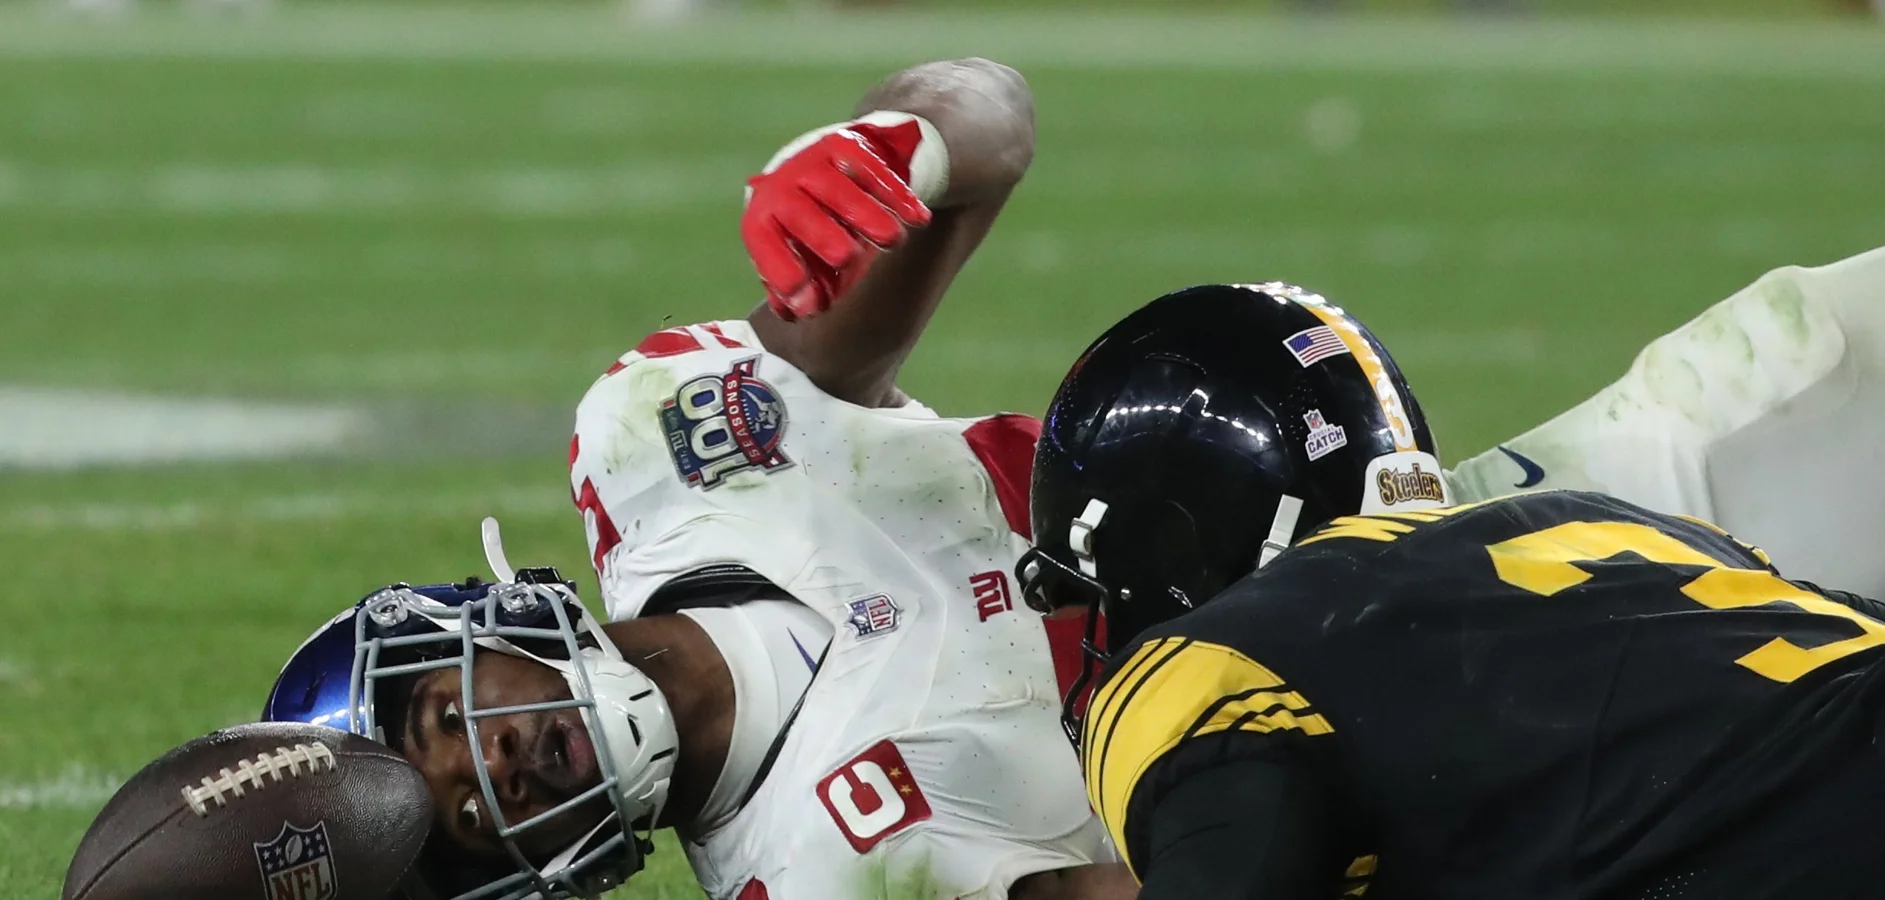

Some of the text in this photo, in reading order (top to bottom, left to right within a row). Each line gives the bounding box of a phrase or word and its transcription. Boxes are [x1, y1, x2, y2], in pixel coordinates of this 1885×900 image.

[678, 376, 752, 487] 100
[726, 380, 761, 457] SEASONS
[1308, 428, 1344, 453] CATCH
[1376, 463, 1444, 506] Steelers
[869, 599, 891, 628] NFL
[828, 760, 906, 838] C
[271, 861, 331, 900] NFL
